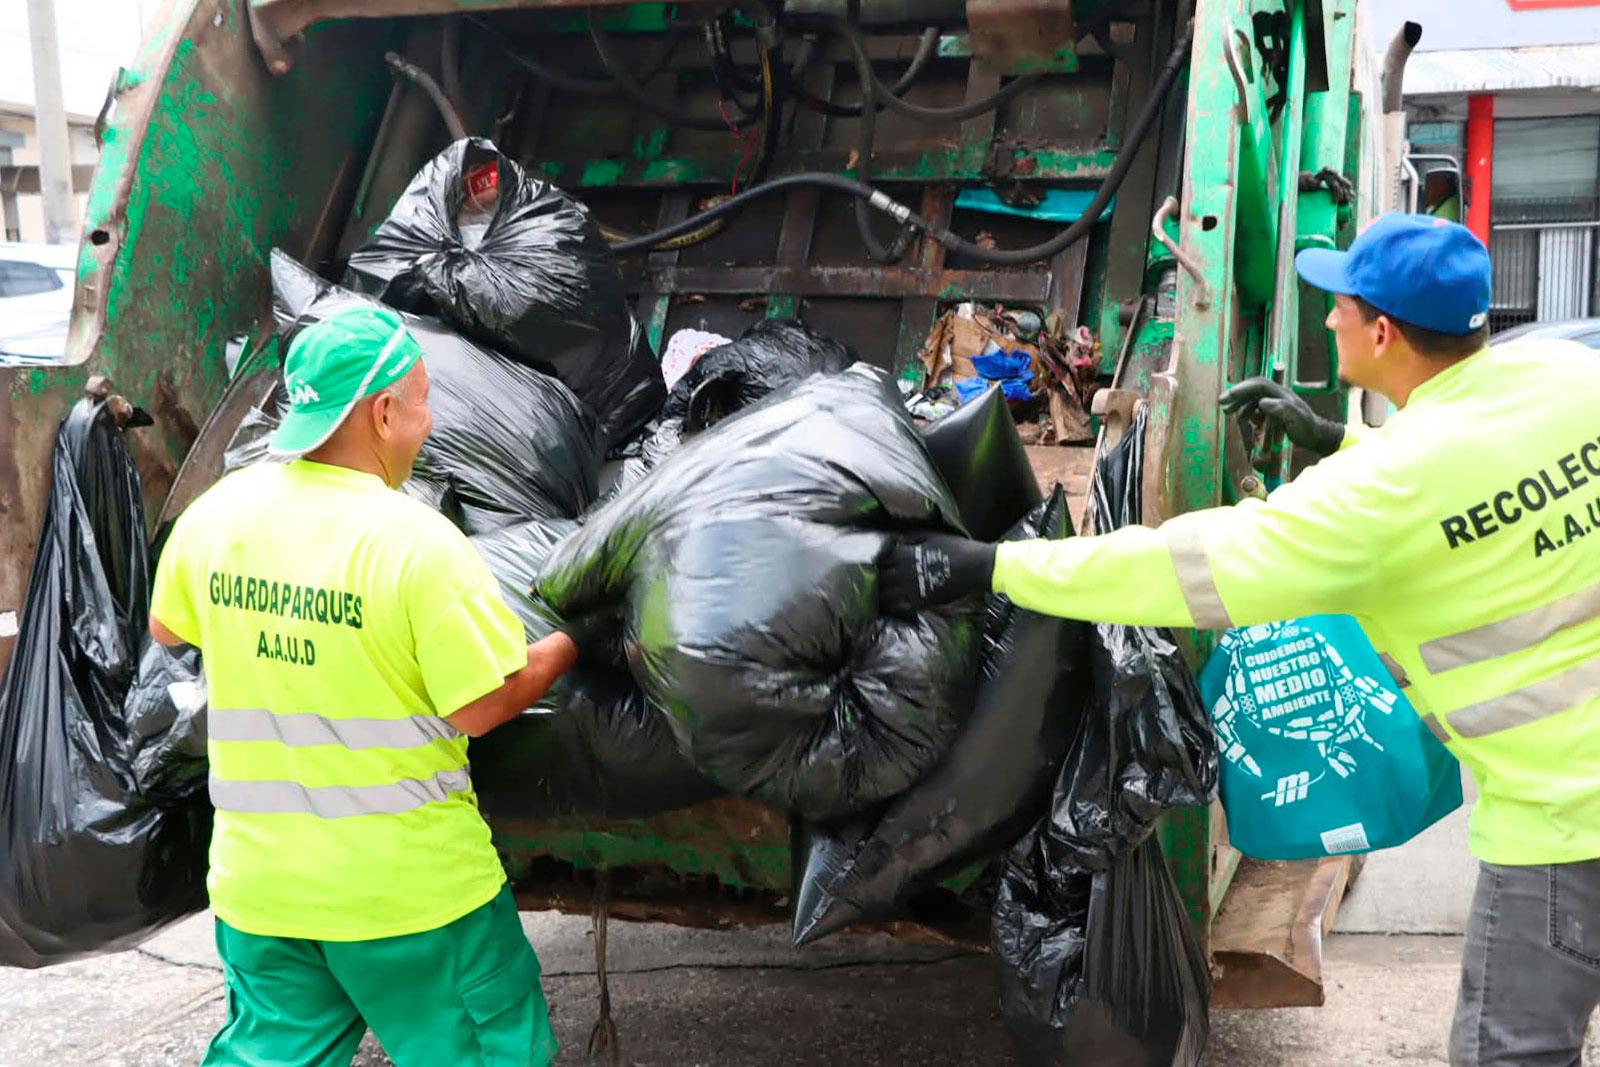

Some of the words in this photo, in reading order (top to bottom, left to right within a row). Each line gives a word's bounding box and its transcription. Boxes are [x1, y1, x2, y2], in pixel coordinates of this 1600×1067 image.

[1440, 436, 1600, 549] RECOLEC
[209, 571, 364, 629] GUARDAPARQUES
[256, 630, 316, 666] A.A.U.D
[1244, 636, 1316, 668] CUIDEMOS
[1249, 651, 1321, 684] NUESTRO
[1254, 668, 1327, 705] MEDIO
[1261, 689, 1332, 721] AMBIENTE
